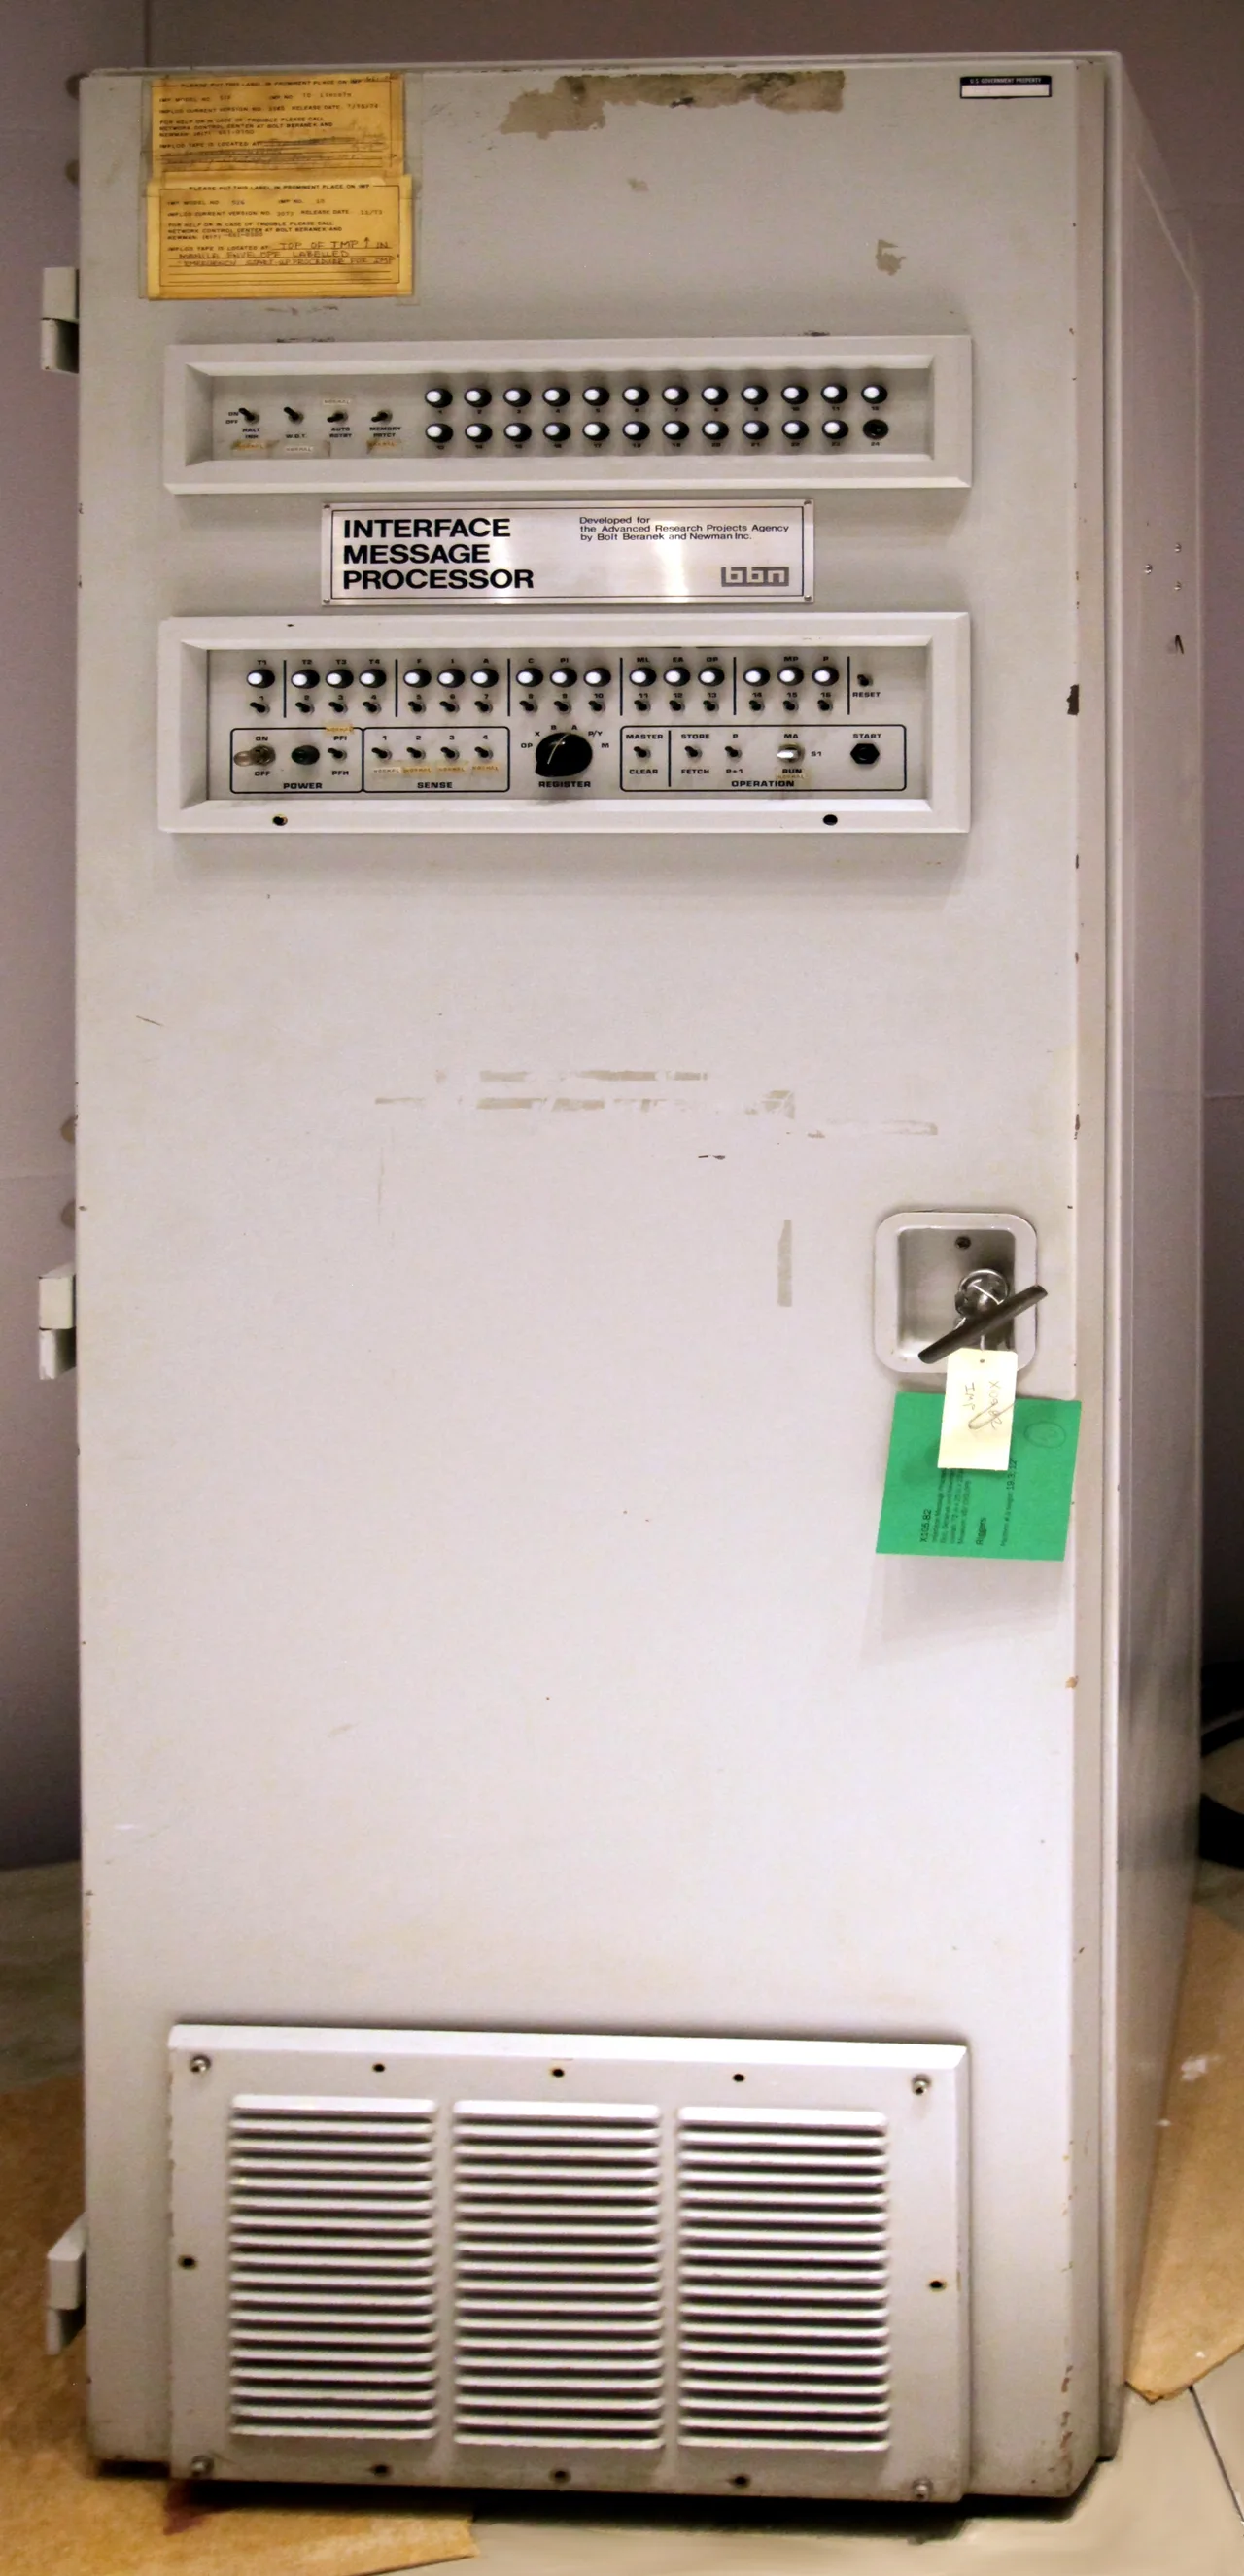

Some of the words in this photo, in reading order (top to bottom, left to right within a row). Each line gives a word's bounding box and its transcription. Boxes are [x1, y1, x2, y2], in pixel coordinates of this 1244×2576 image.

[344, 518, 511, 538] INTERFACE
[580, 532, 592, 541] by
[707, 525, 747, 533] Projects
[344, 544, 491, 565] MESSAGE
[344, 569, 534, 589] PROCESSOR
[721, 567, 789, 587] bbn
